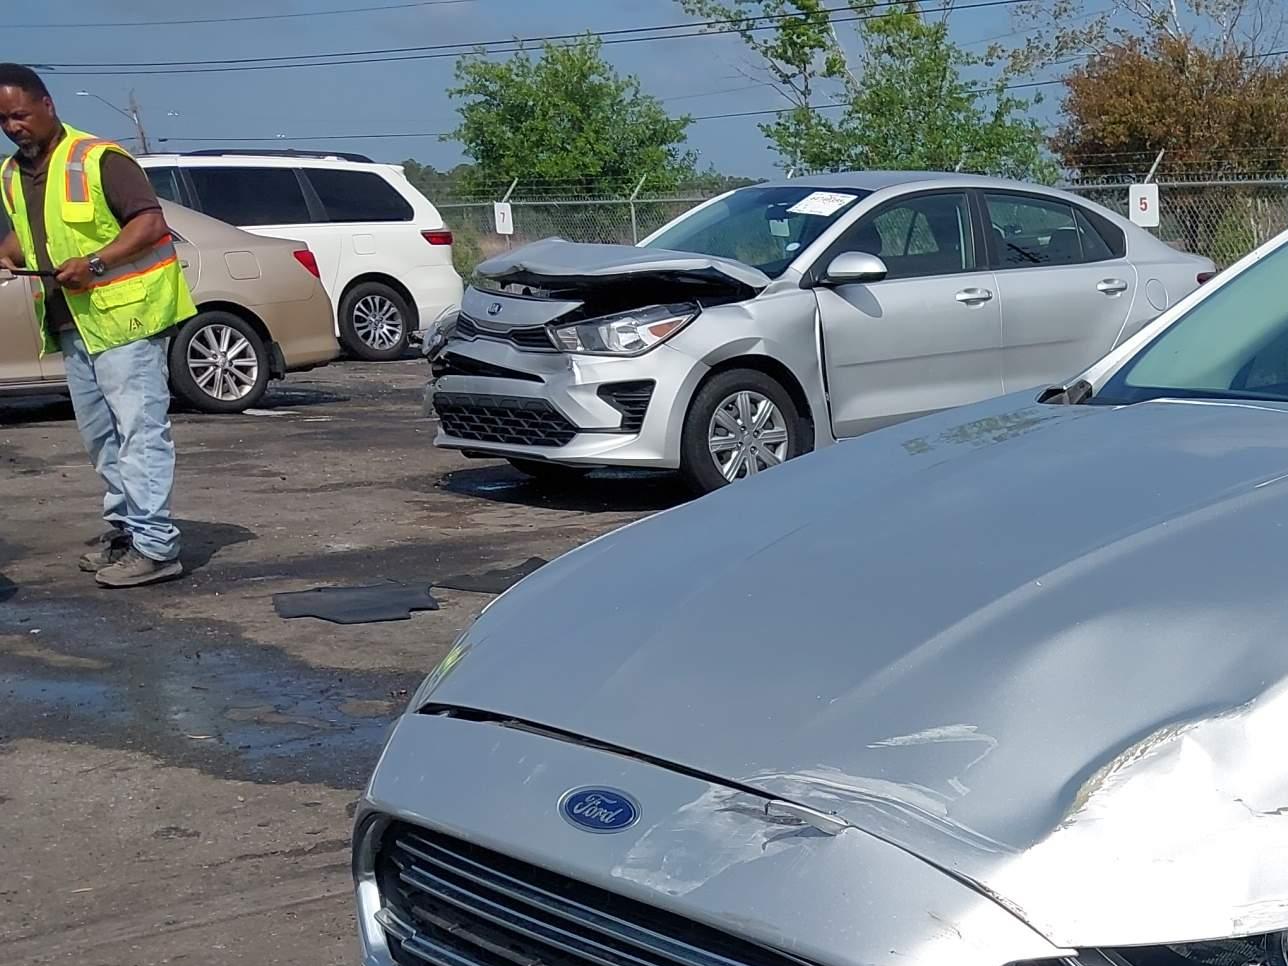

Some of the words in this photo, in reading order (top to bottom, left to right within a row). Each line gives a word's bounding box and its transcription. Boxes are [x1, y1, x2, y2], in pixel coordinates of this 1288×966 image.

[1139, 196, 1148, 212] 5
[500, 211, 506, 223] 7
[573, 793, 624, 824] Ford
